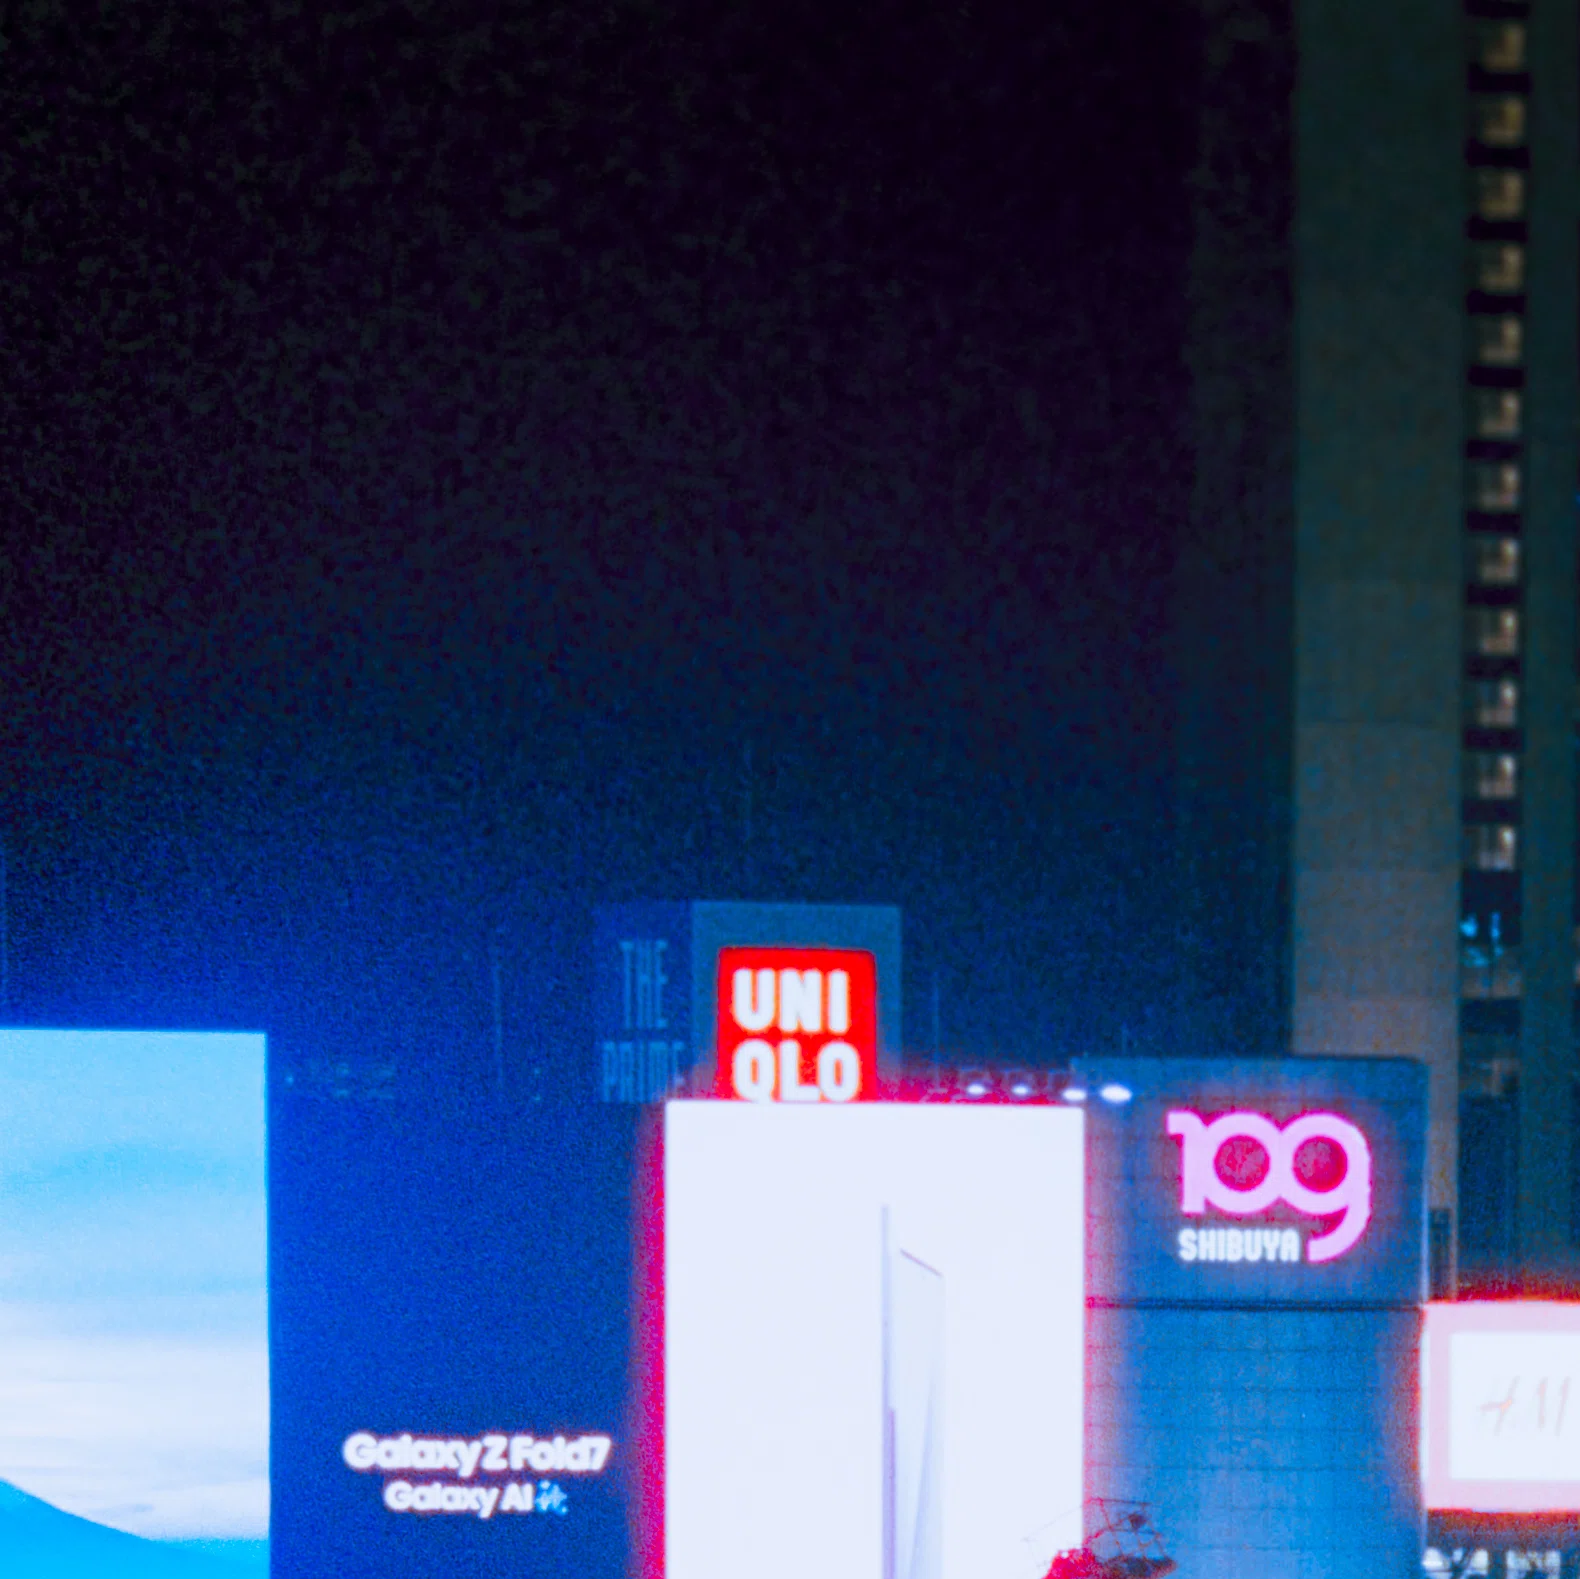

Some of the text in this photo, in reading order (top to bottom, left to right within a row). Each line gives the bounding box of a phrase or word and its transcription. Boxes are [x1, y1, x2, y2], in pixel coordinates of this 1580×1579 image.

[731, 968, 851, 1034] UNI
[731, 1039, 861, 1102] QLO
[1166, 1110, 1372, 1264] 109
[1178, 1229, 1300, 1262] SHIBUYA
[343, 1433, 612, 1477] Galaxy Z Fold7
[383, 1481, 534, 1519] Galaxy AI
